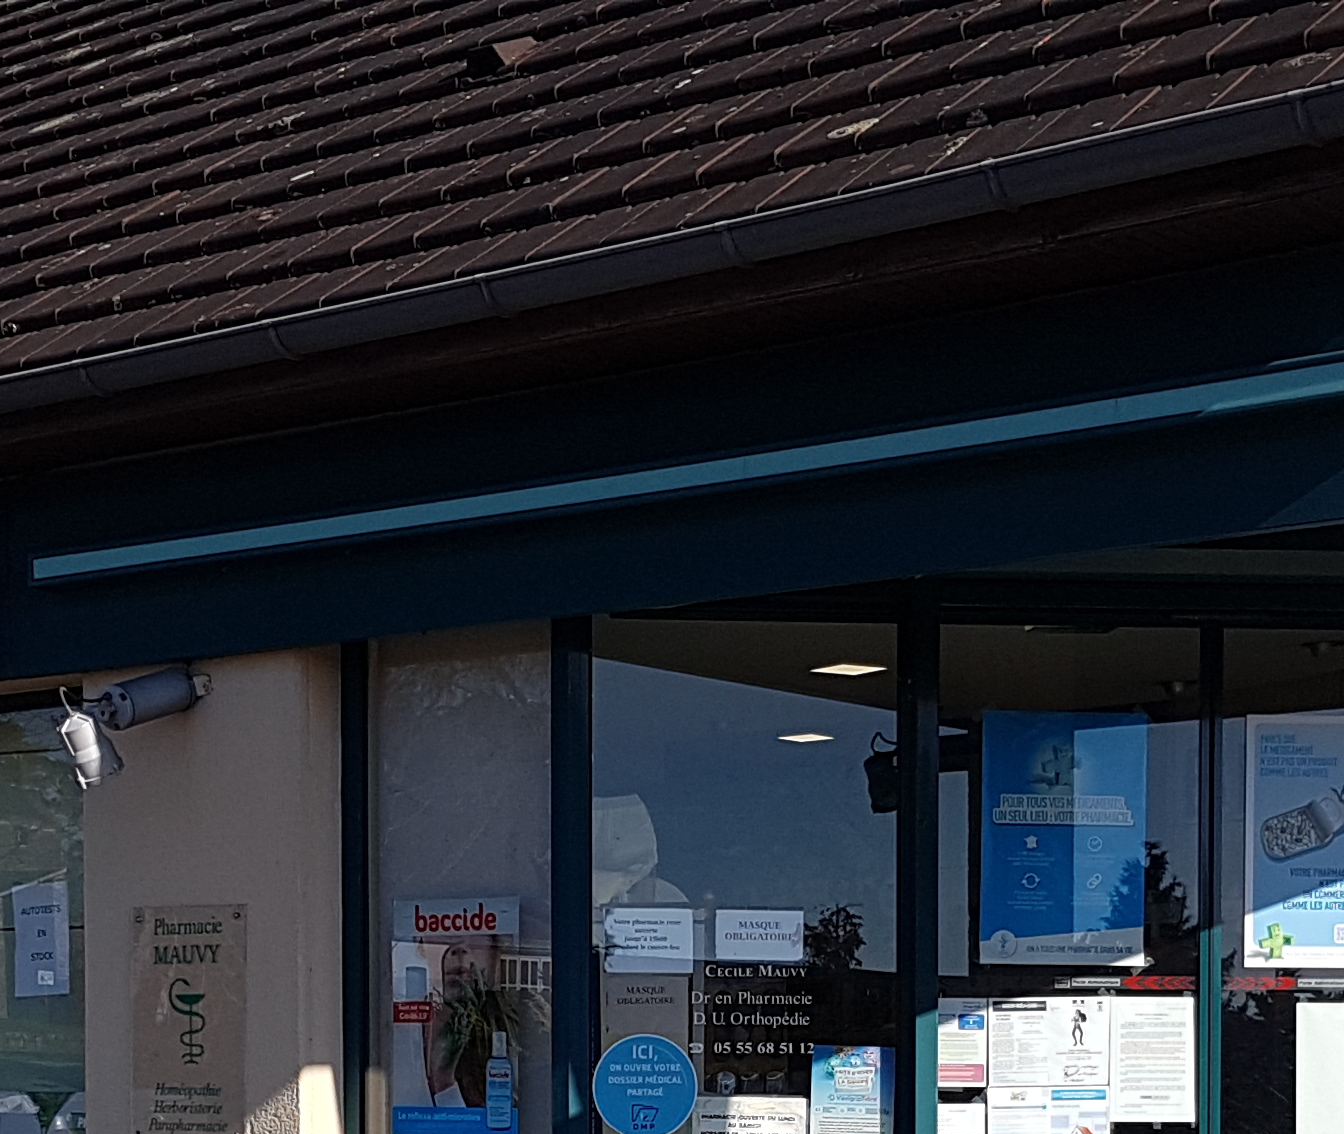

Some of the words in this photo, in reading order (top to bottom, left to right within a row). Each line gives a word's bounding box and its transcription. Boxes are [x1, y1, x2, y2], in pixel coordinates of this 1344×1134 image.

[1309, 901, 1323, 910] LES
[414, 902, 497, 932] baccide
[153, 916, 223, 936] Pharmacie
[738, 921, 781, 930] MASQUE
[37, 929, 47, 938] EN
[724, 932, 794, 941] OBLIGATOIRE
[30, 952, 54, 961] STOCK
[153, 944, 222, 965] MAUVY
[626, 986, 666, 994] MASQUE
[690, 991, 711, 1004] Dr
[714, 994, 733, 1004] en
[738, 991, 813, 1004] Pharmacie
[730, 1011, 811, 1029] Orthopédie
[713, 1042, 731, 1054] 05
[735, 1042, 753, 1054] 55
[757, 1042, 775, 1054] 68
[778, 1042, 794, 1054] 51
[799, 1042, 815, 1054] 12
[632, 1045, 658, 1062] ICI,
[609, 1063, 622, 1072] ON
[623, 1063, 652, 1072] OUVRE
[654, 1063, 681, 1072] VOTRE
[608, 1076, 643, 1084] DOSSIER
[645, 1074, 683, 1084] MÉDICAL
[154, 1082, 222, 1100] Homéopathie
[626, 1086, 664, 1096] PARTAGÉ
[153, 1100, 223, 1114] Herboristerie
[397, 1111, 405, 1120] Le
[148, 1117, 229, 1134] Parapharmacie
[632, 1123, 656, 1131] DMP
